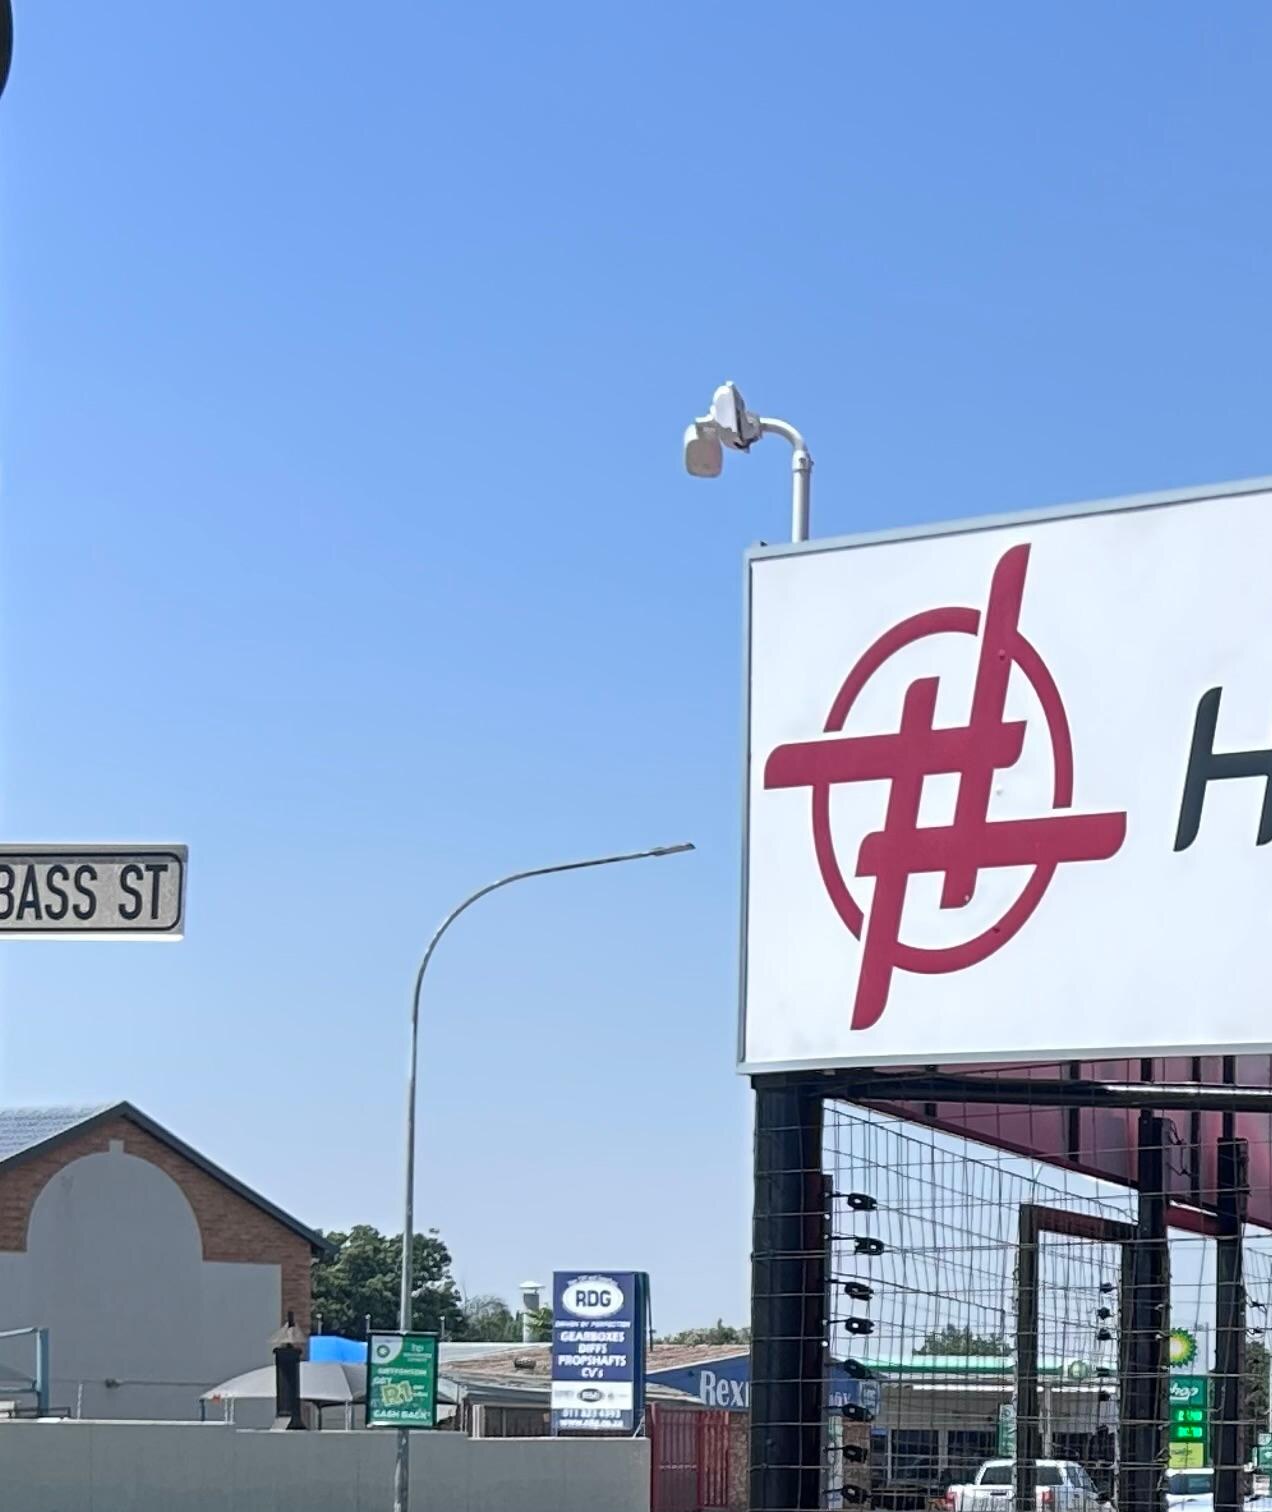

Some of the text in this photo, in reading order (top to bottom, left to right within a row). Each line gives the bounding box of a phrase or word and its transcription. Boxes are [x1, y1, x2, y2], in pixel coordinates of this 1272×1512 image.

[119, 864, 168, 920] ST
[575, 1290, 612, 1307] RDG
[560, 1331, 625, 1343] GEARBOXES
[577, 1343, 607, 1354] DIFFS
[558, 1355, 627, 1367] PROPSHAFTS
